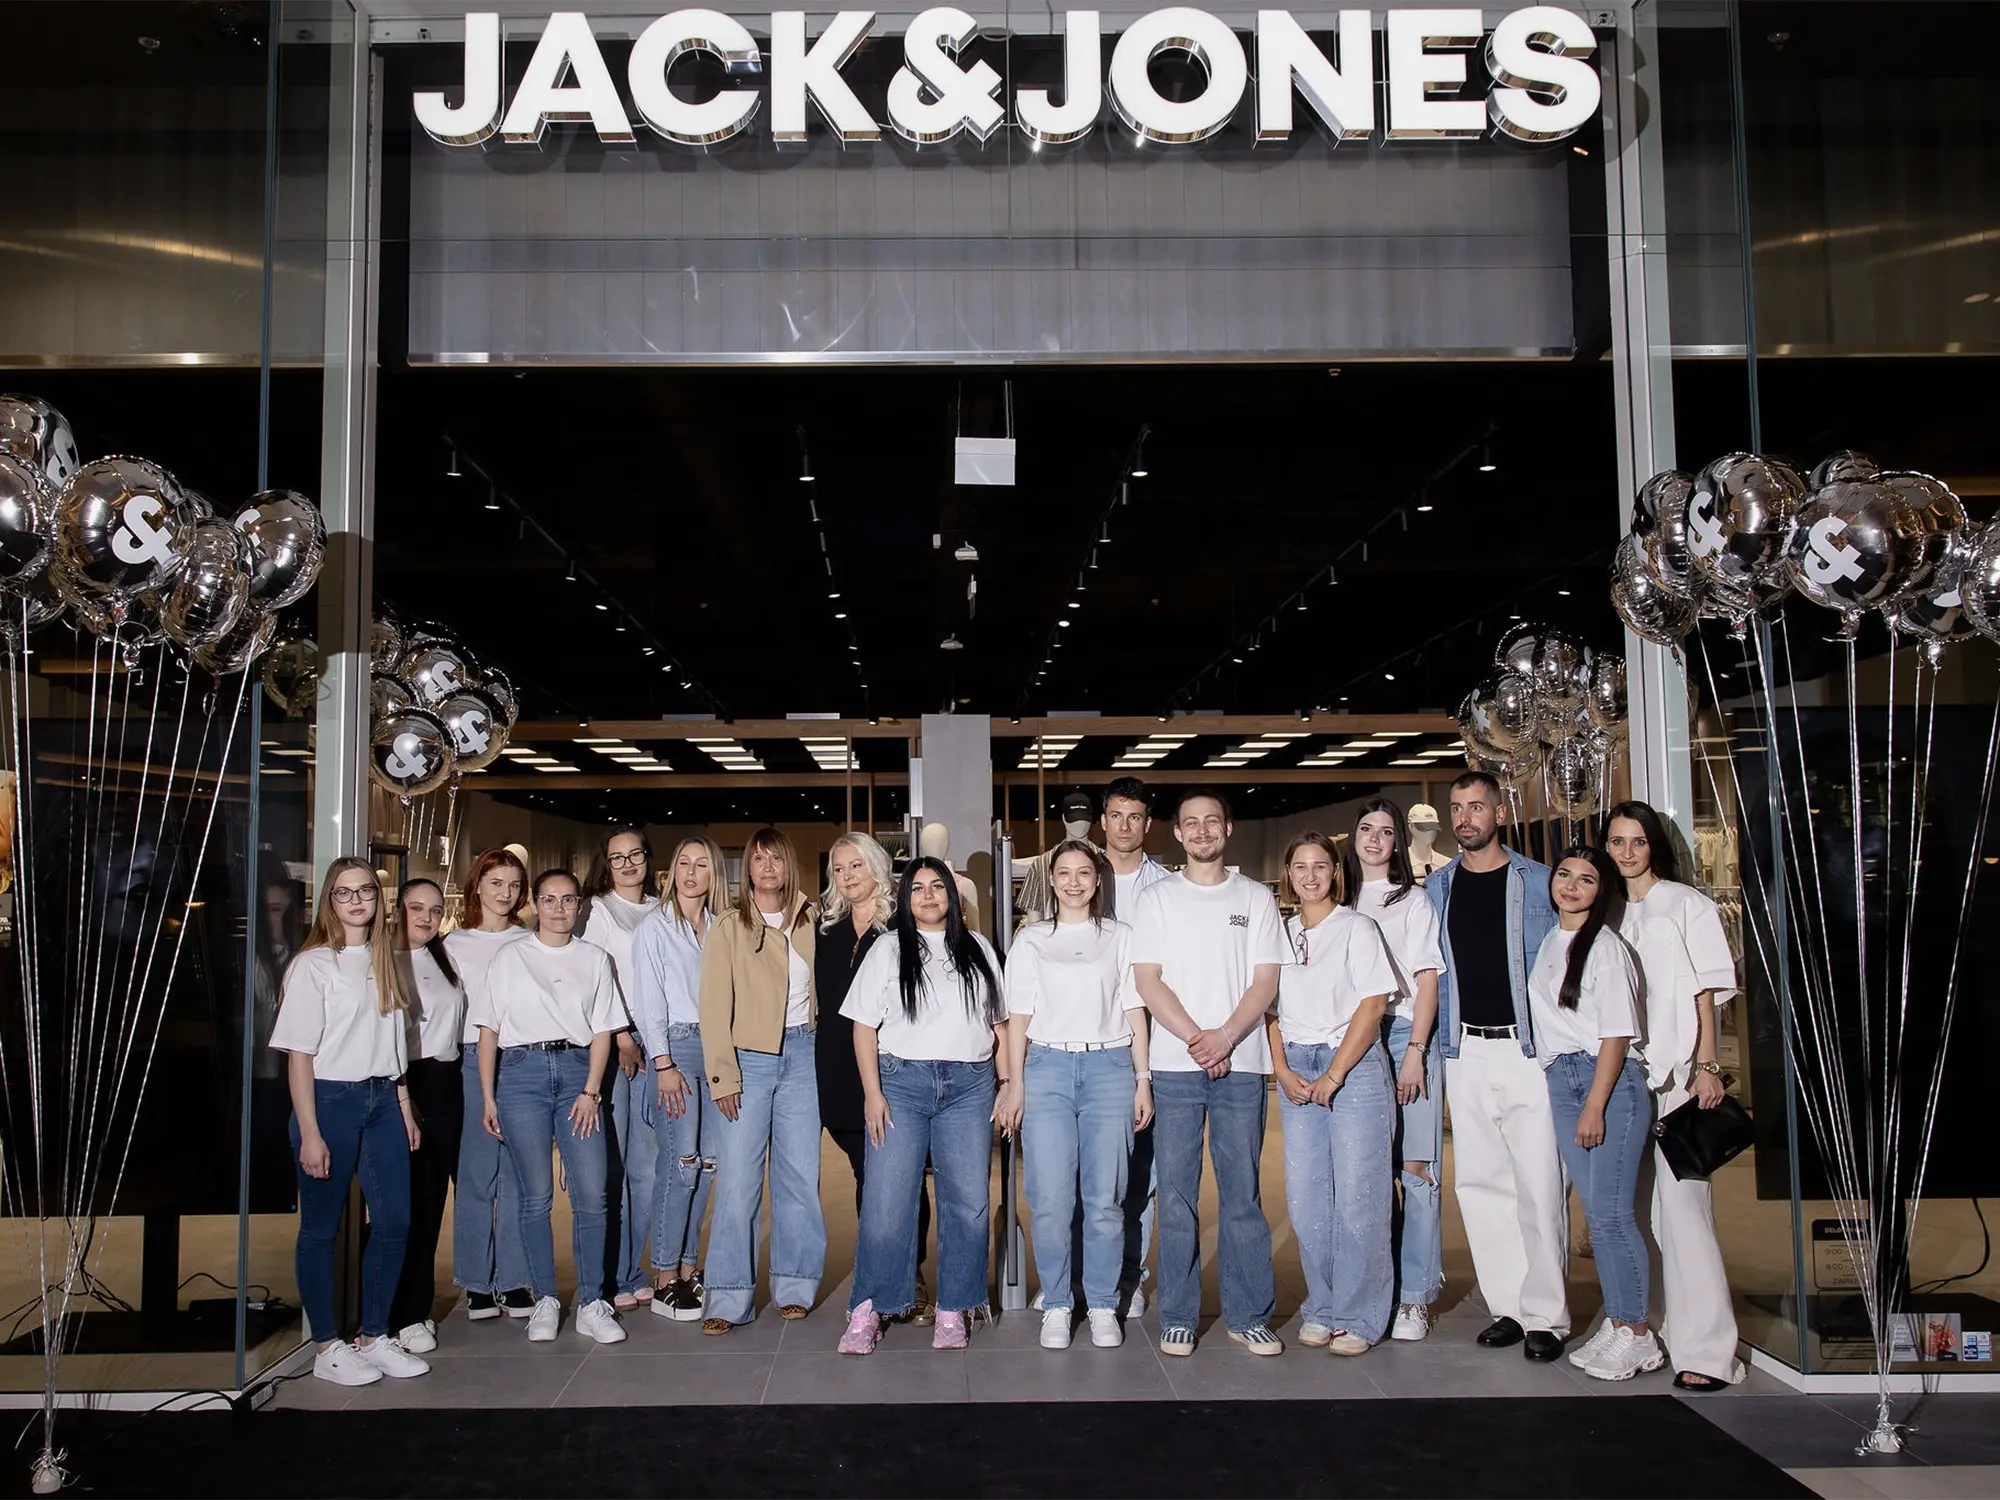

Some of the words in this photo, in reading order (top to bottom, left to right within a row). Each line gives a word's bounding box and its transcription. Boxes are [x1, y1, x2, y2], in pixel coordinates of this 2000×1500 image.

[413, 7, 1601, 146] JACK&JONES
[112, 495, 173, 570] &
[1804, 517, 1865, 584] &
[385, 733, 428, 778] &
